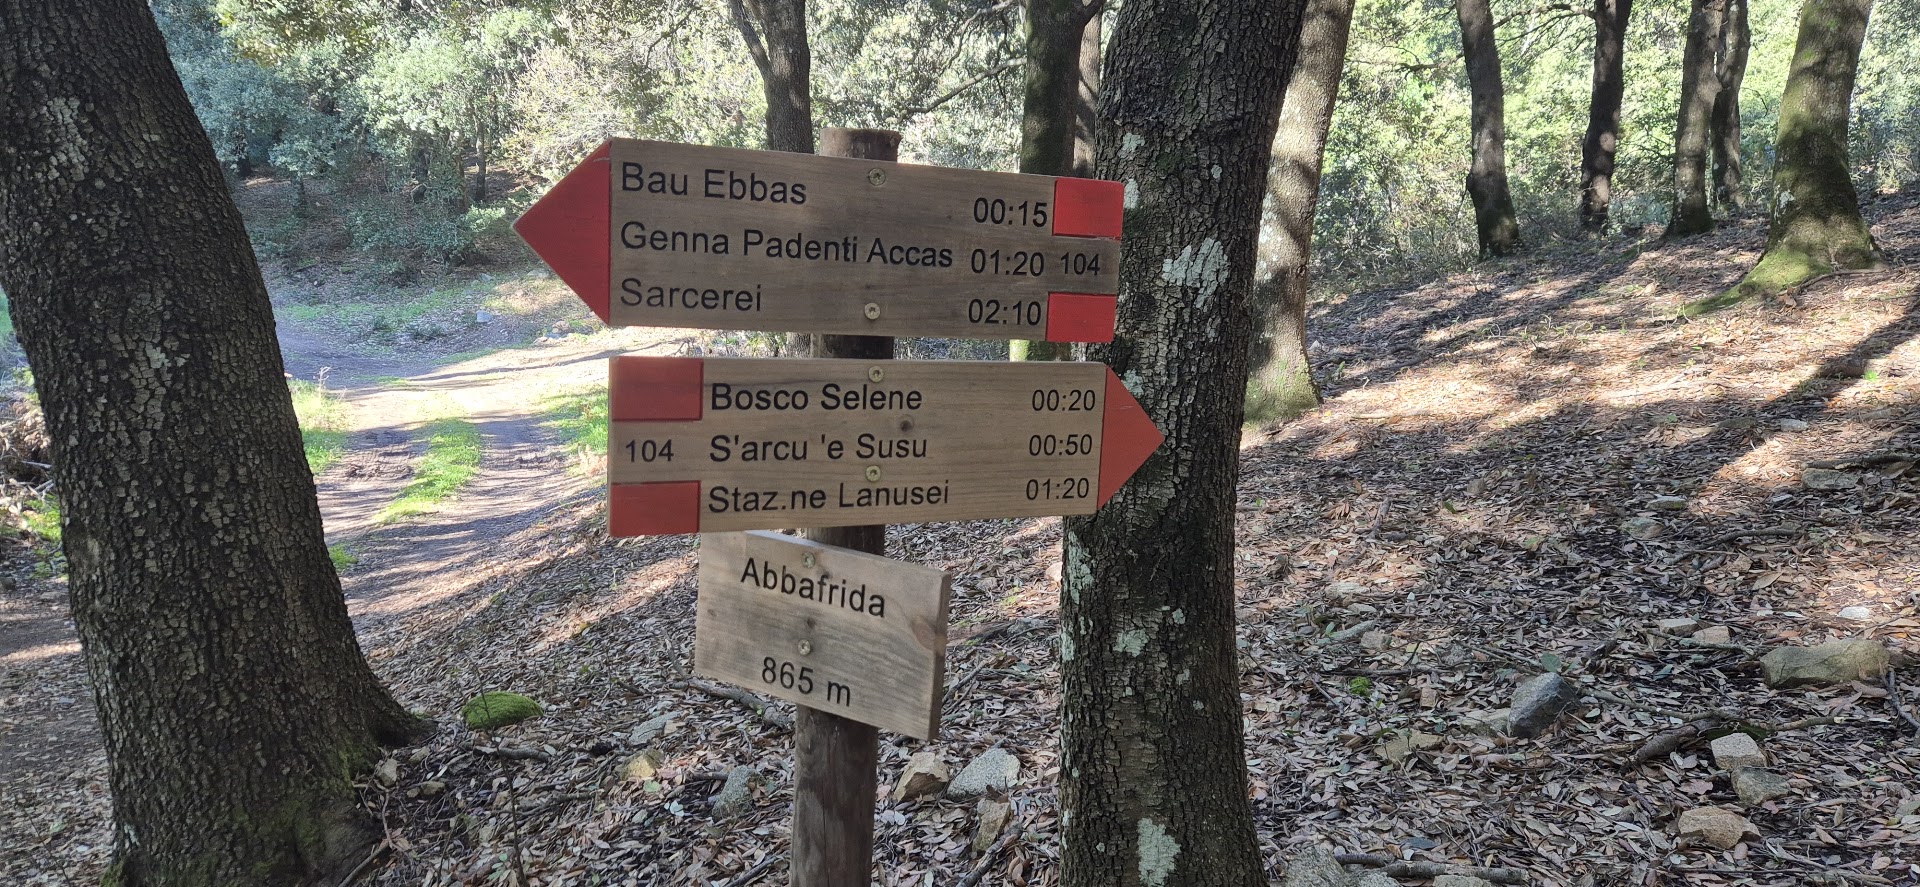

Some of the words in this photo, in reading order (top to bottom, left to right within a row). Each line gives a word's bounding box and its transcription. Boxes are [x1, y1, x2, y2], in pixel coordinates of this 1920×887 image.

[622, 162, 689, 195] Bau
[704, 169, 807, 204] Ebbas
[973, 197, 1047, 227] 00:15
[621, 221, 729, 254] Genna
[743, 233, 857, 264] Padenti
[867, 239, 953, 268] Accas
[971, 250, 1045, 277] 01:20
[1060, 253, 1101, 275] 104
[621, 278, 762, 312] Sarcerei
[968, 299, 1042, 326] 02:10
[711, 383, 809, 411] Bosco
[820, 383, 922, 411] Selene
[1032, 389, 1096, 411] 00:20
[625, 440, 674, 463] 104
[710, 434, 808, 463] S'arcu
[821, 434, 844, 459] 'e
[856, 432, 927, 459] Susu
[1028, 434, 1093, 457] 00:50
[709, 486, 826, 514] Staz.ne
[839, 480, 949, 508] Lanusei
[1026, 477, 1090, 501] 01:20
[741, 557, 885, 618] Abbafrida
[762, 656, 813, 694] 865
[828, 681, 850, 706] m
